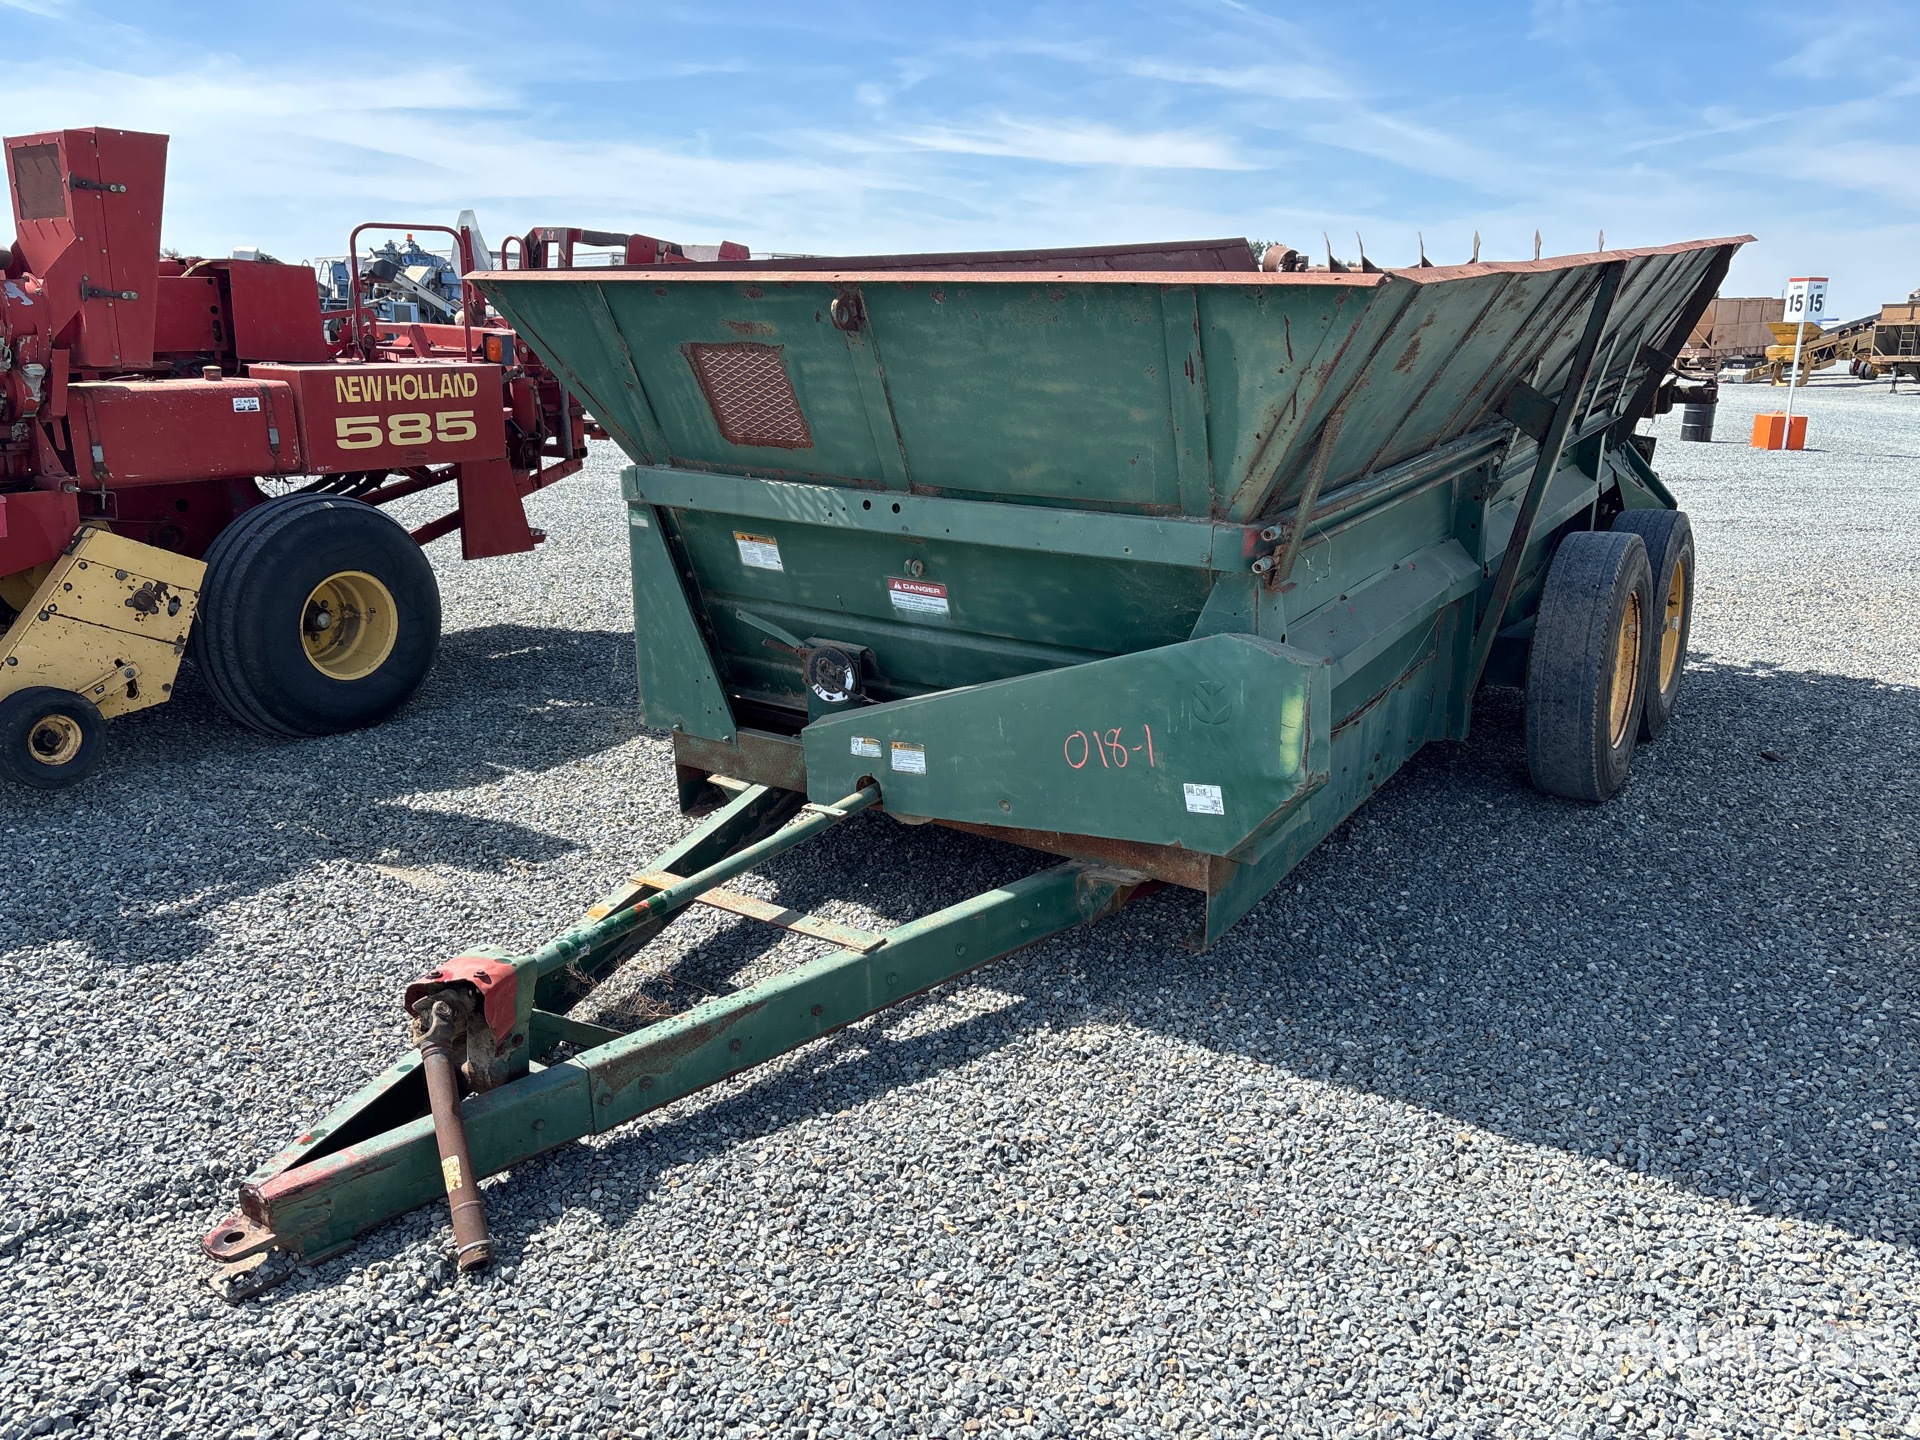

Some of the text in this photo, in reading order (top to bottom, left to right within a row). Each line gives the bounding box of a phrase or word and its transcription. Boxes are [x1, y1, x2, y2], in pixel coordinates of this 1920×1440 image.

[1789, 293, 1804, 312] 15
[1809, 293, 1824, 312] 15
[335, 372, 478, 403] NEW HOLLAND
[335, 410, 477, 450] 585
[902, 583, 941, 595] DANGER
[1064, 723, 1155, 769] 018-1
